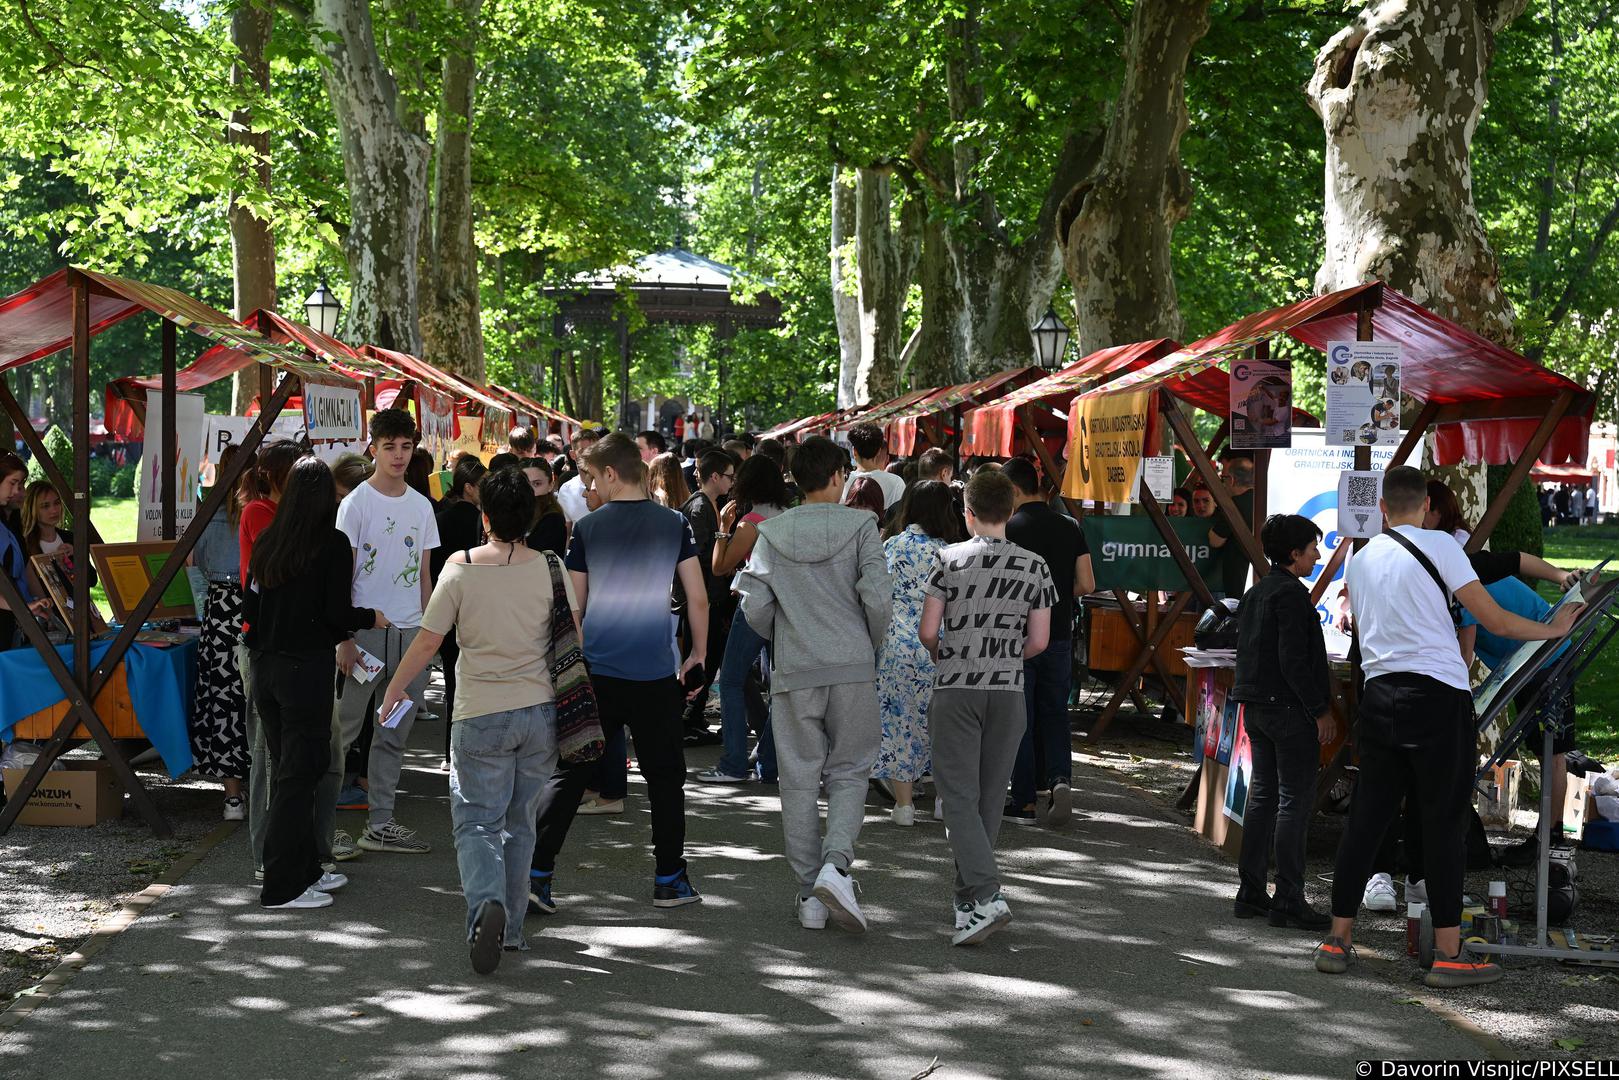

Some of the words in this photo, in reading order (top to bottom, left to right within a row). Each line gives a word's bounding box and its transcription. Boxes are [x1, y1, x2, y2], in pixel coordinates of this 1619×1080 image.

[319, 397, 352, 428] GIMNAZIJA
[1294, 460, 1355, 470] GRADITELJSK
[1107, 466, 1125, 482] ZAGREB
[181, 508, 192, 519] KLUB
[1102, 541, 1210, 563] gimnaija
[31, 789, 72, 799] ONZUM
